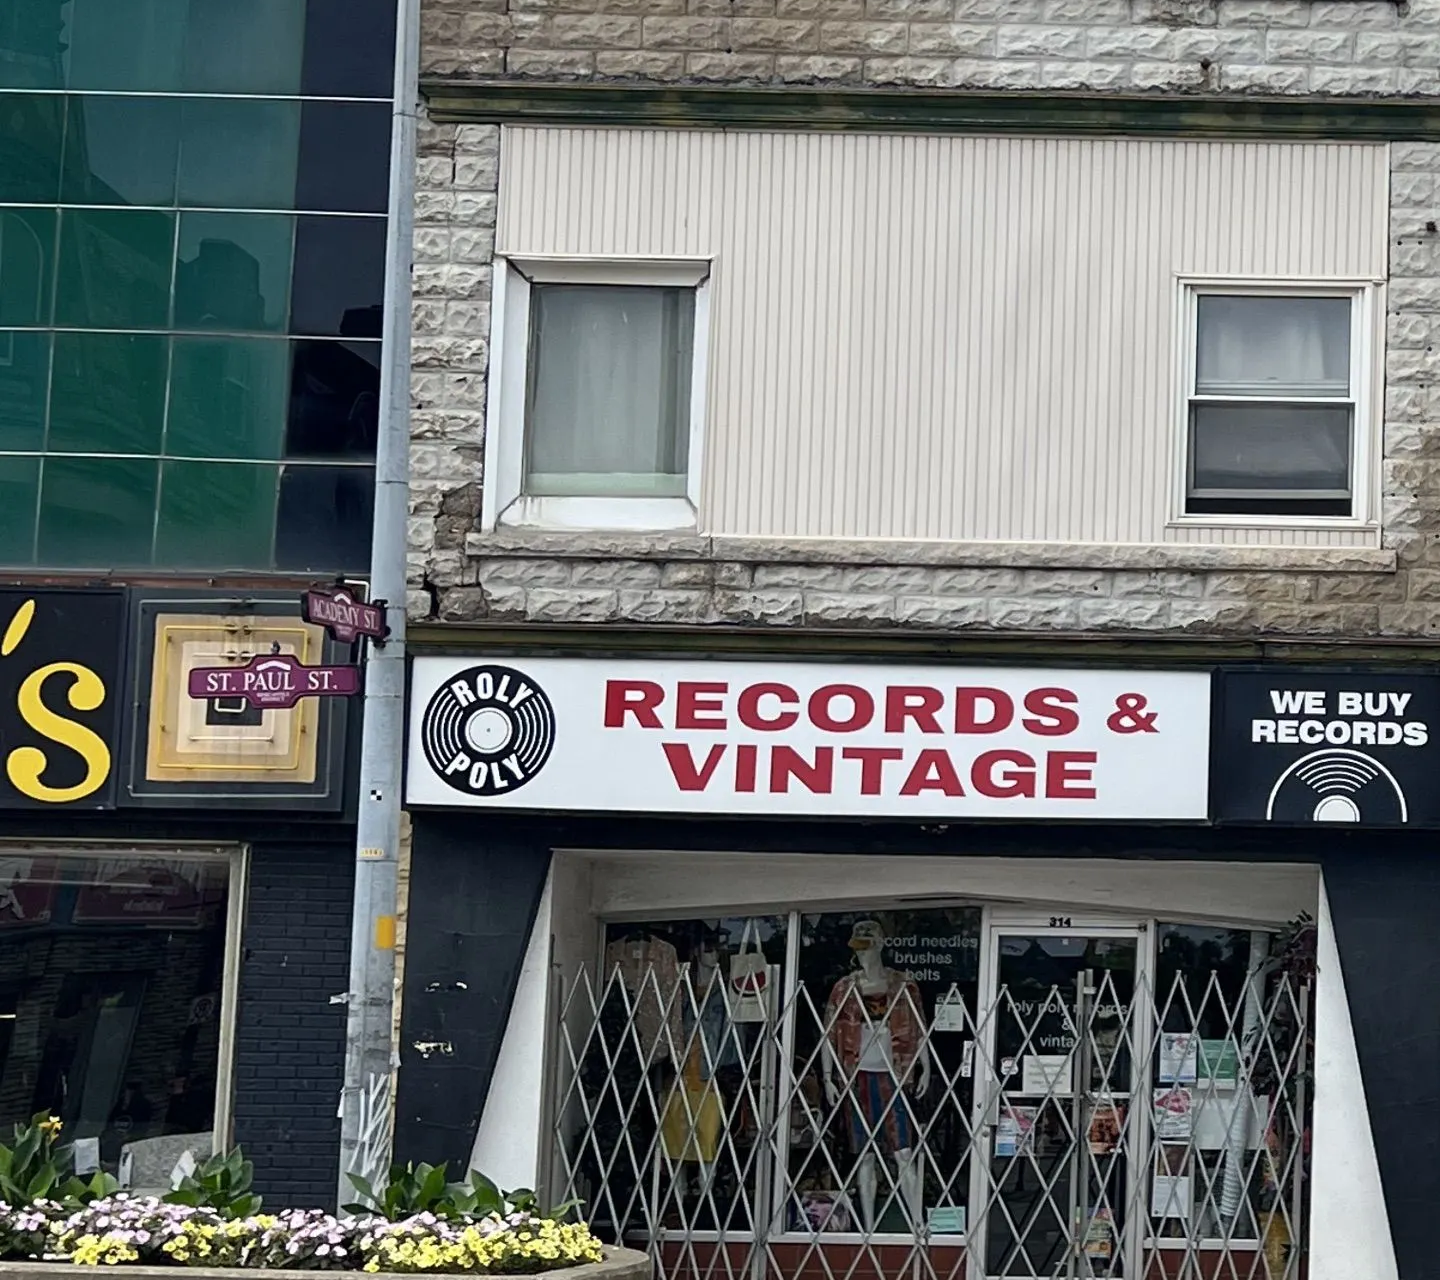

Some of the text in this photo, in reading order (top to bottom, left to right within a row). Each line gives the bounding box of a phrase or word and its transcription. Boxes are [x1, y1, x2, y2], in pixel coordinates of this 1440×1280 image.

[313, 599, 360, 627] ACADEMY
[206, 671, 338, 692] ST. PAUL ST.
[450, 672, 534, 709] ROLY
[603, 678, 1161, 735] RECORDS &
[1270, 689, 1412, 716] WE BUY
[1251, 719, 1428, 746] RECORDS
[444, 751, 525, 789] POLY
[662, 742, 1098, 799] VINTAGE
[1050, 917, 1071, 927] 314
[921, 934, 978, 948] needles
[894, 952, 952, 964] brushes
